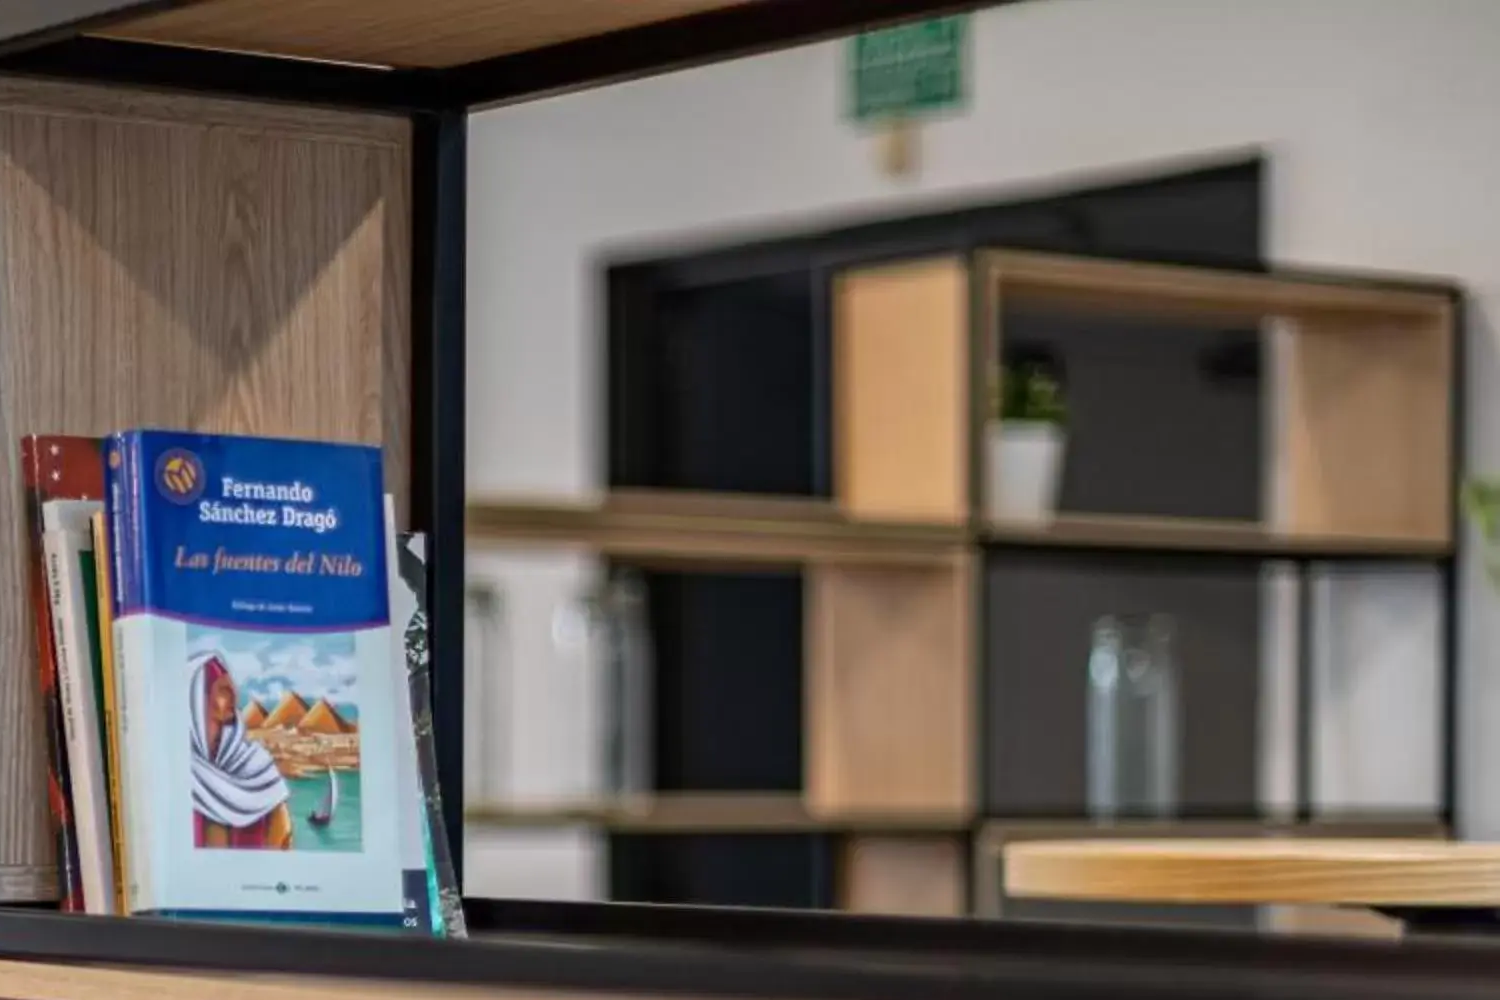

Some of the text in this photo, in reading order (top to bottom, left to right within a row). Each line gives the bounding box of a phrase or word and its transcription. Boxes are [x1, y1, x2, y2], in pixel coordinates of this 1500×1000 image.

[222, 477, 313, 503] Fernando
[199, 500, 337, 533] Sánchez Dragó
[174, 545, 363, 576] Las fuentes del Nilo
